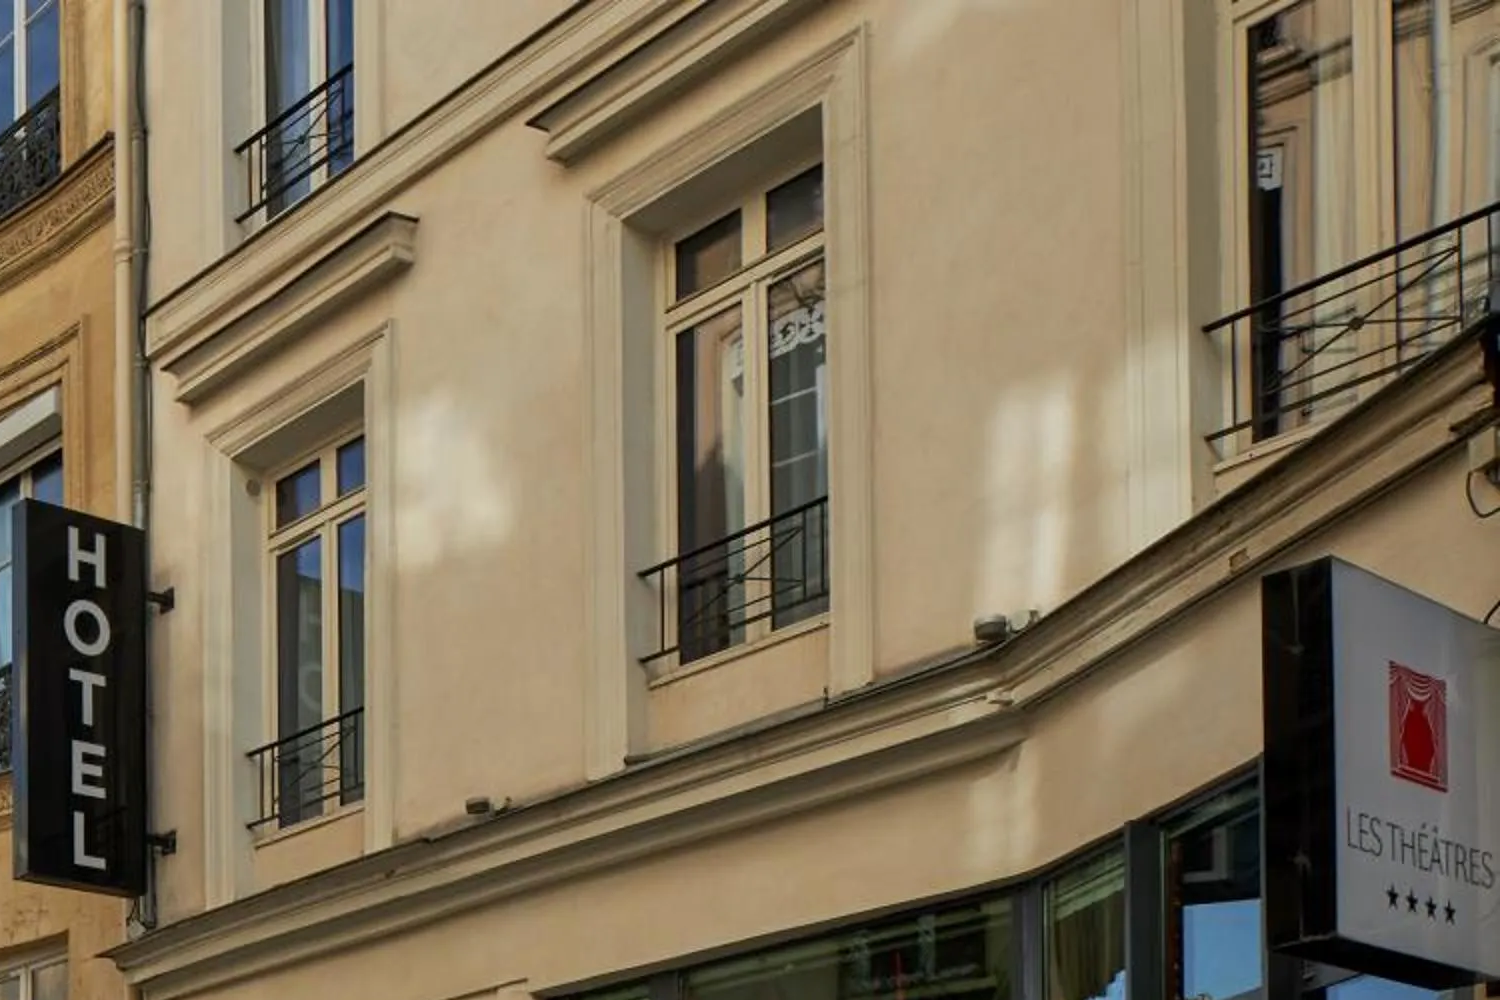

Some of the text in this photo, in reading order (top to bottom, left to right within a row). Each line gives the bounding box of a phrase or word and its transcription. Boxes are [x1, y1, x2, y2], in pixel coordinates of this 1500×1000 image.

[63, 525, 111, 871] HOTEL
[1346, 805, 1496, 890] LES THÉÂTRES
